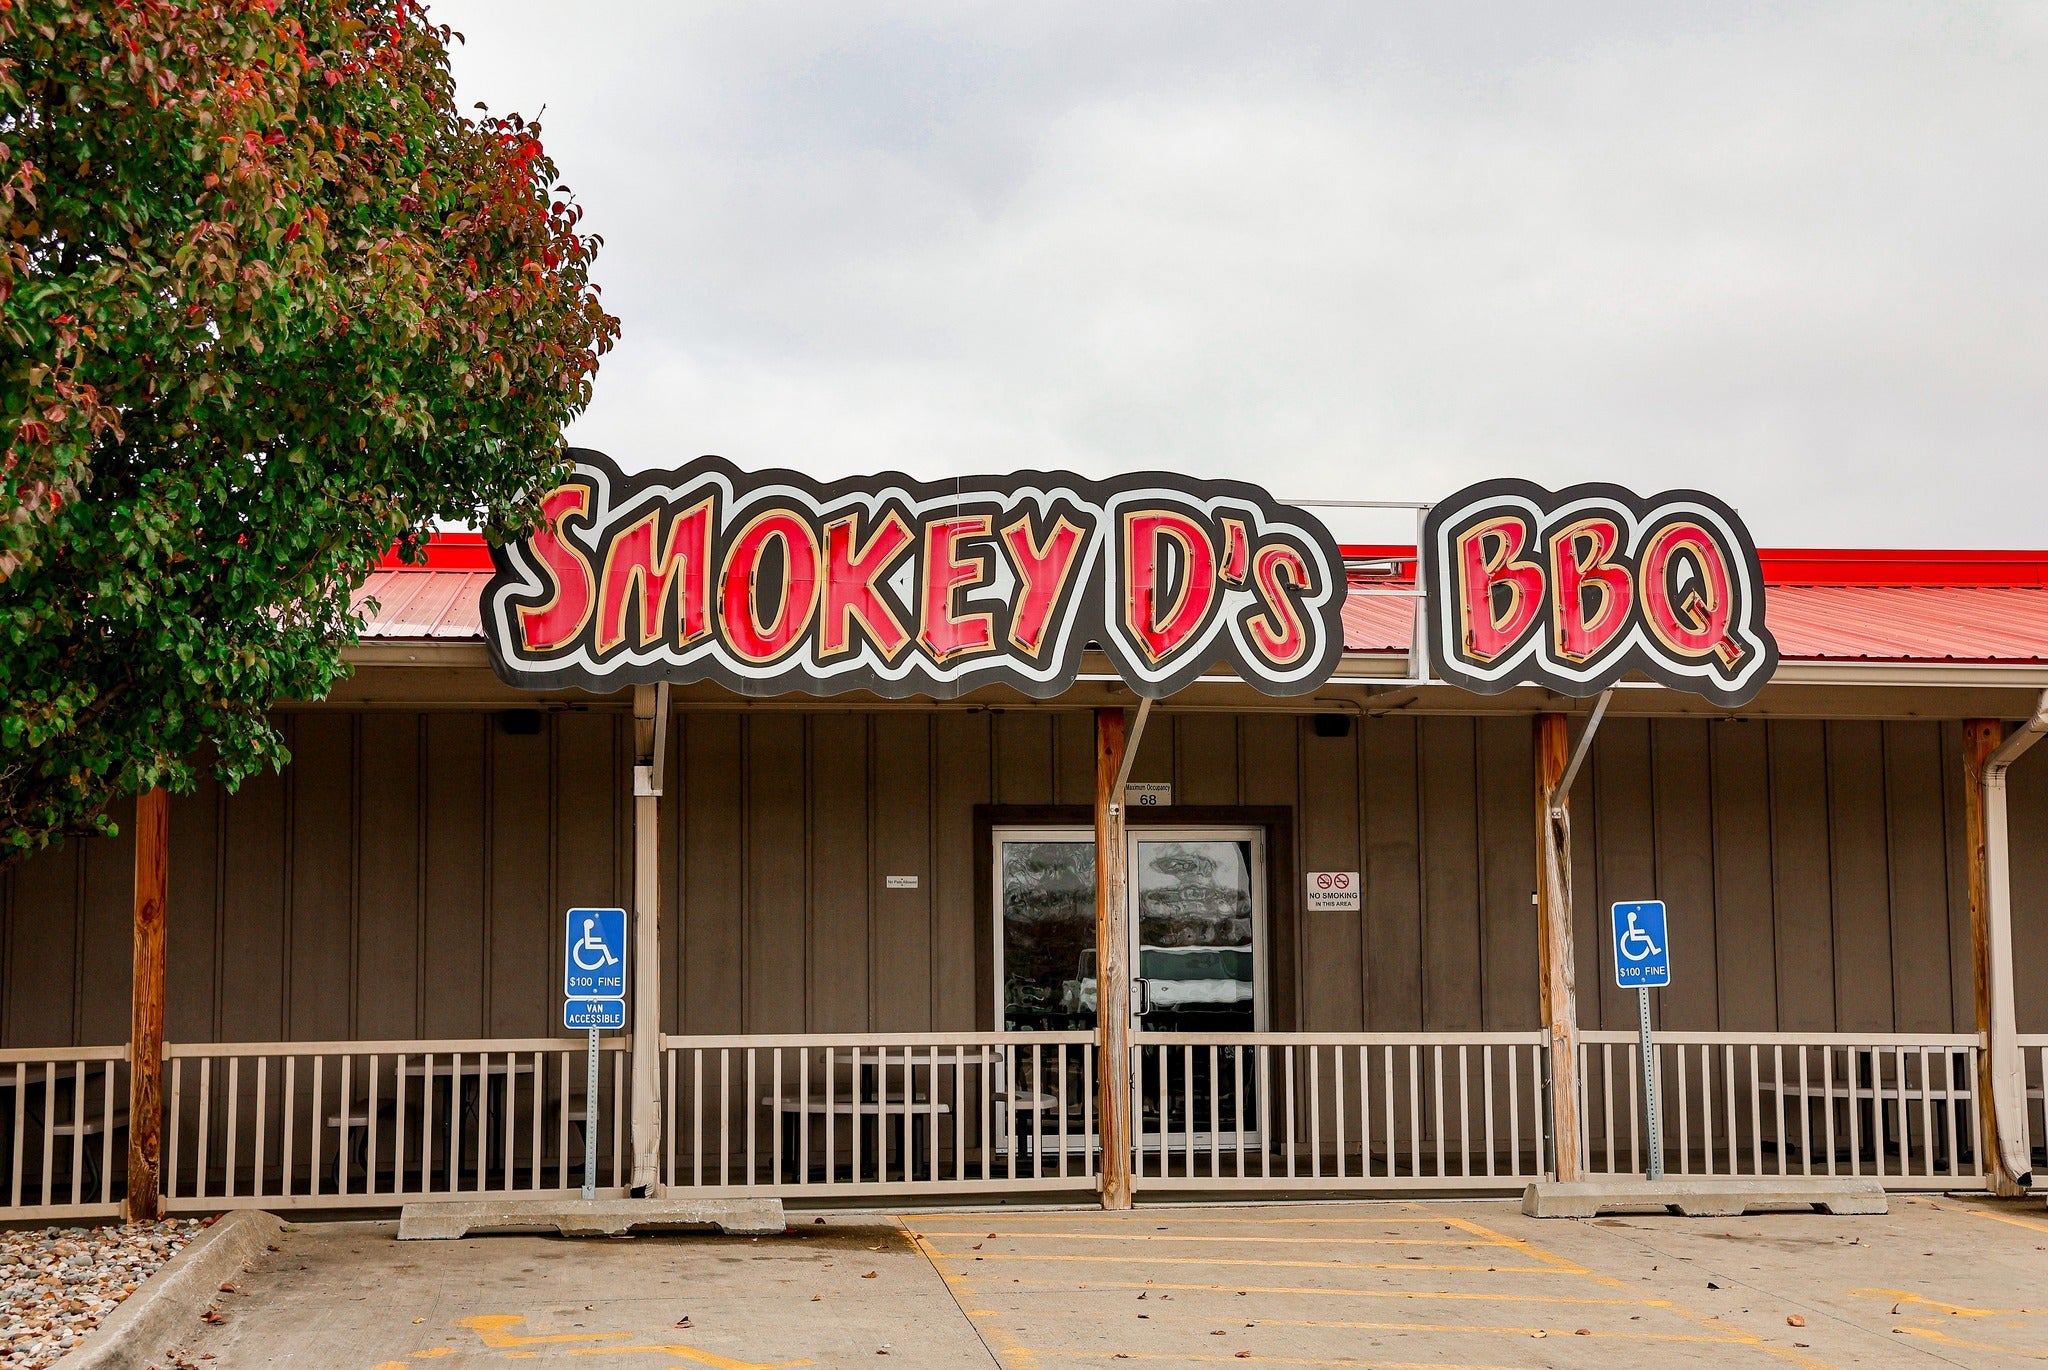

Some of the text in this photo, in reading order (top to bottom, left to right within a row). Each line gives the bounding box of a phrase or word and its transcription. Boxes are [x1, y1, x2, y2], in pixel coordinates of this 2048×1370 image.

[515, 483, 1085, 663] SMOKEY
[1456, 516, 1746, 672] BBQ
[1146, 784, 1170, 792] Occupancy
[1140, 794, 1157, 806] 68
[1620, 966, 1666, 977] $100 FINE
[570, 977, 621, 987] $100 FINE
[586, 1004, 604, 1012] VAN
[569, 1014, 620, 1023] ACCESSIBLE
